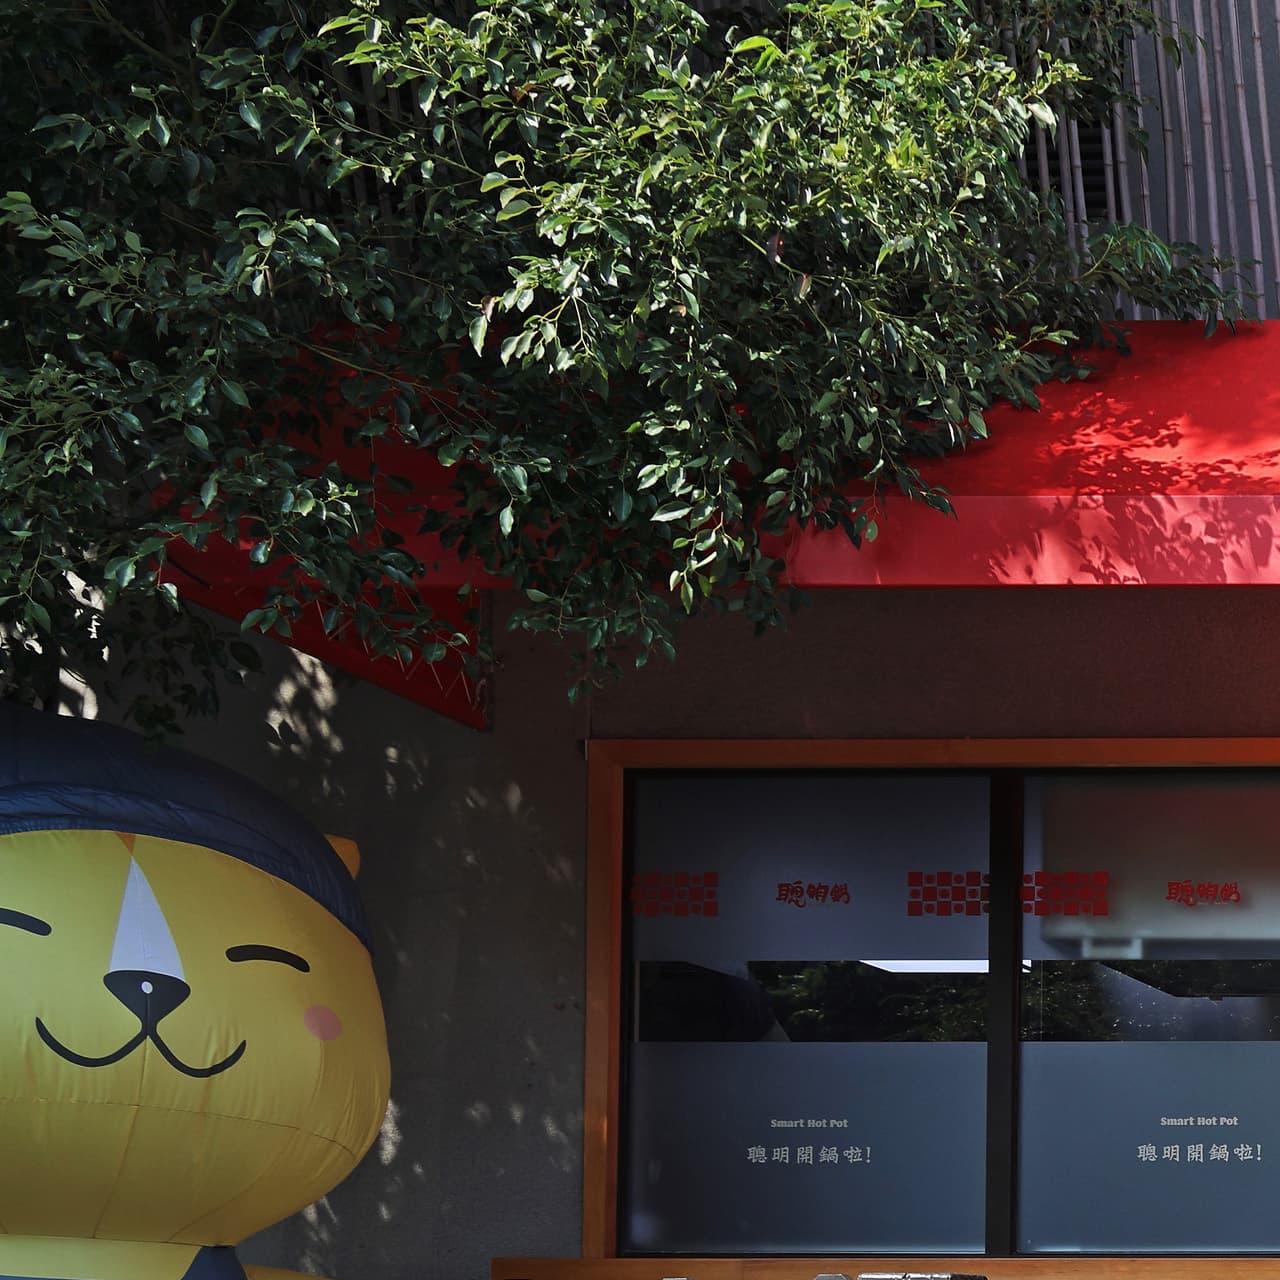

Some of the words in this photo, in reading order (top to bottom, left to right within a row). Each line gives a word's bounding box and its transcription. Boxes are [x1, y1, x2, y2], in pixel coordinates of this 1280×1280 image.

[770, 1119, 804, 1128] Smart
[807, 1119, 827, 1128] Hot
[829, 1119, 848, 1128] Pot
[1160, 1116, 1195, 1126] Smart
[1197, 1116, 1218, 1126] Hot
[1220, 1116, 1239, 1126] Pot
[747, 1145, 871, 1165] 聰明開鍋啦!
[1137, 1143, 1262, 1162] 聰明開鍋啦!
